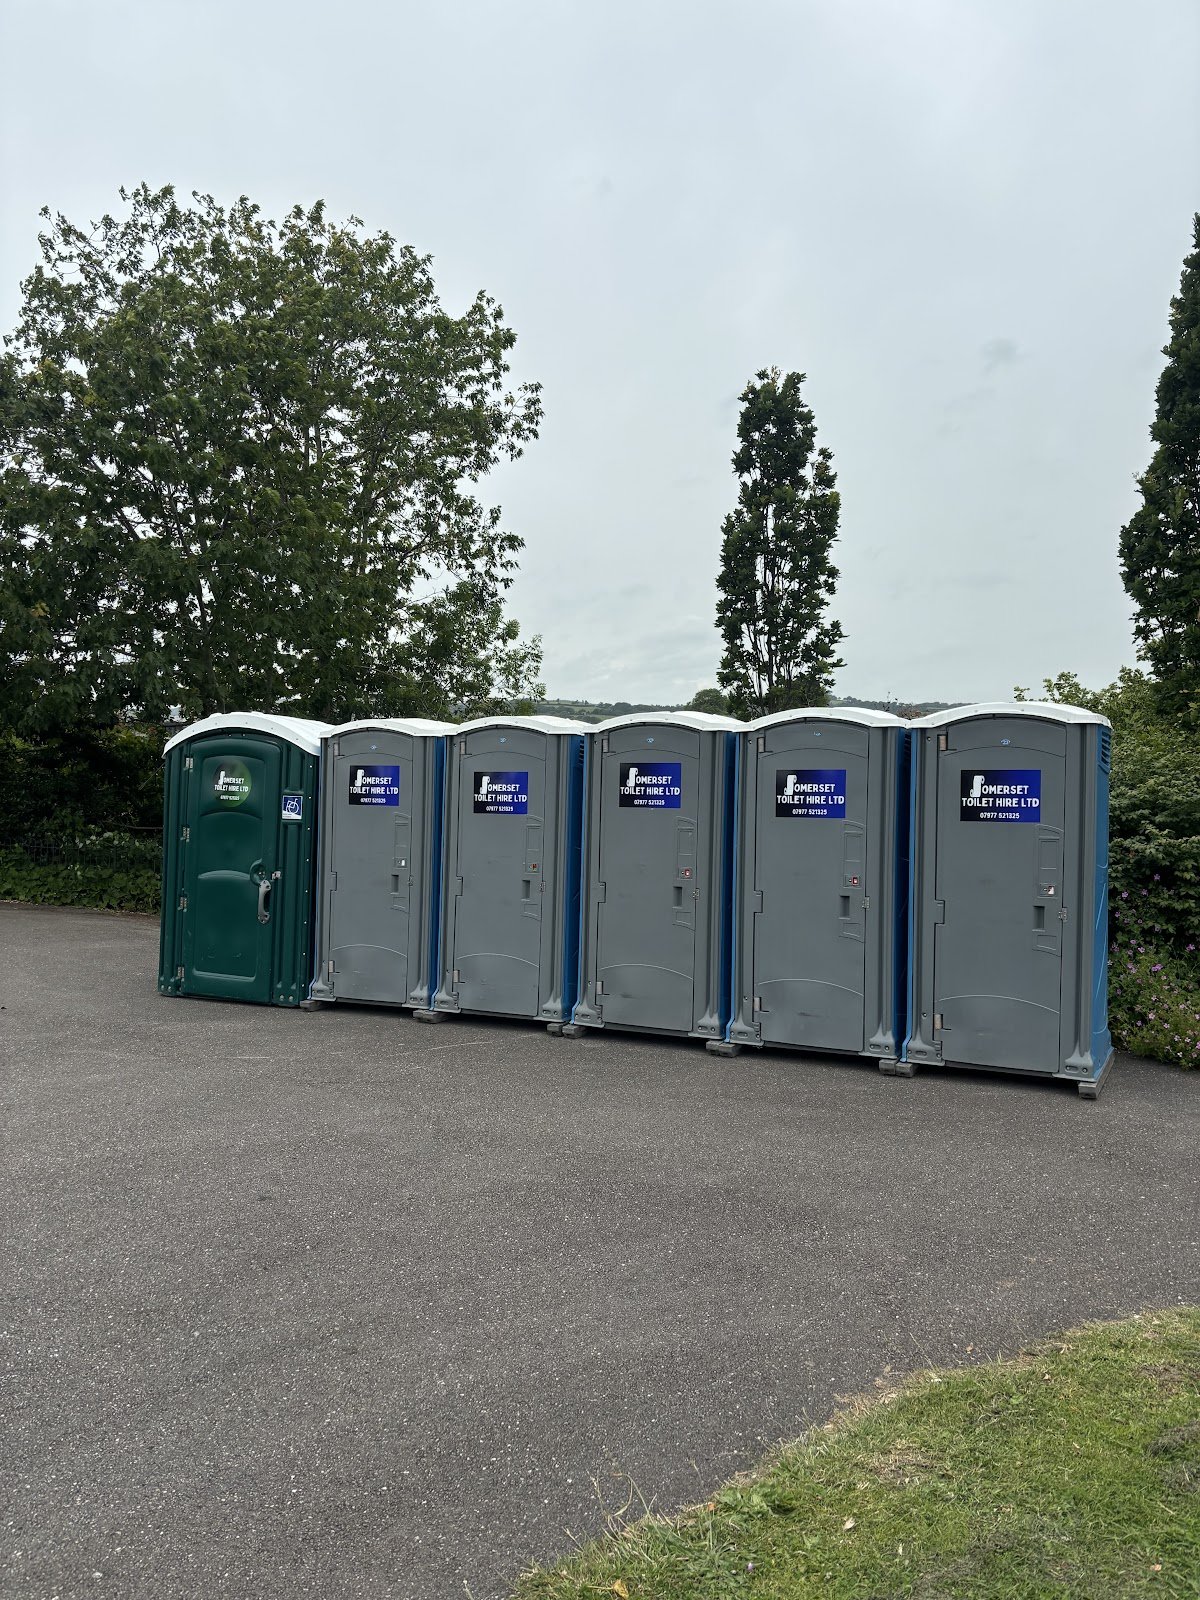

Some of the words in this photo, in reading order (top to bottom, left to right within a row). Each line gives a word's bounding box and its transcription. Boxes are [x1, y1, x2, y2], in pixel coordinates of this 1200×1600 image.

[350, 786, 370, 794] TOILET
[620, 786, 645, 794] TOILET
[646, 787, 664, 795] HIRE
[665, 787, 680, 795] LTD
[497, 794, 513, 802] HIRE
[776, 795, 804, 803] TOILET
[806, 796, 826, 804] HIRE
[828, 796, 845, 804] LTD
[961, 797, 994, 806] TOILET
[995, 798, 1019, 807] HIRE
[1021, 798, 1040, 807] LTD
